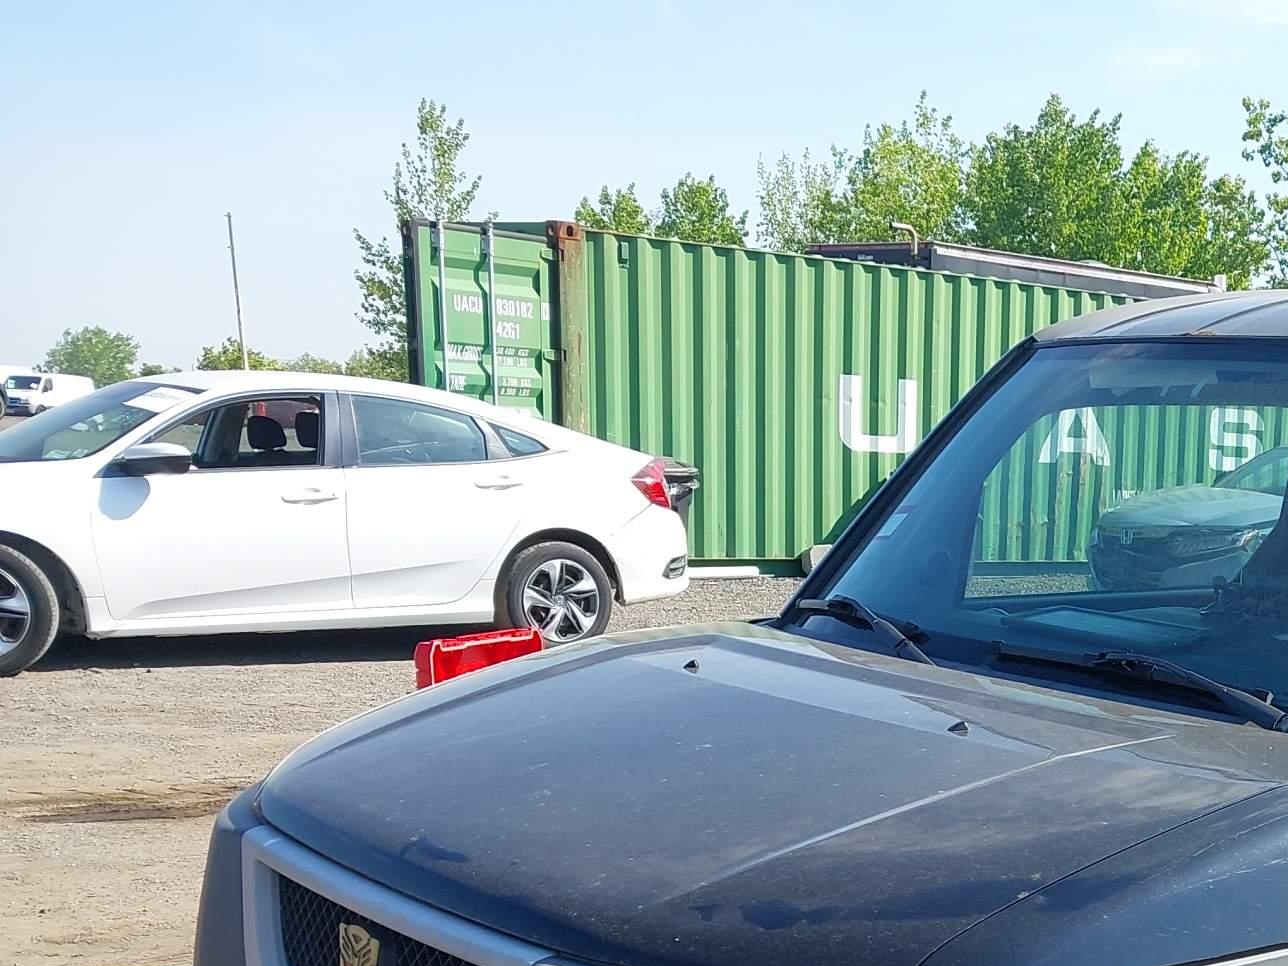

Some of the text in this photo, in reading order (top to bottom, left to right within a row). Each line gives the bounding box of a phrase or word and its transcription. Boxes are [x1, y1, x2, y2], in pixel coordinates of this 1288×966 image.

[453, 294, 483, 314] UACU
[496, 298, 534, 319] 830182
[496, 321, 520, 340] 42G1
